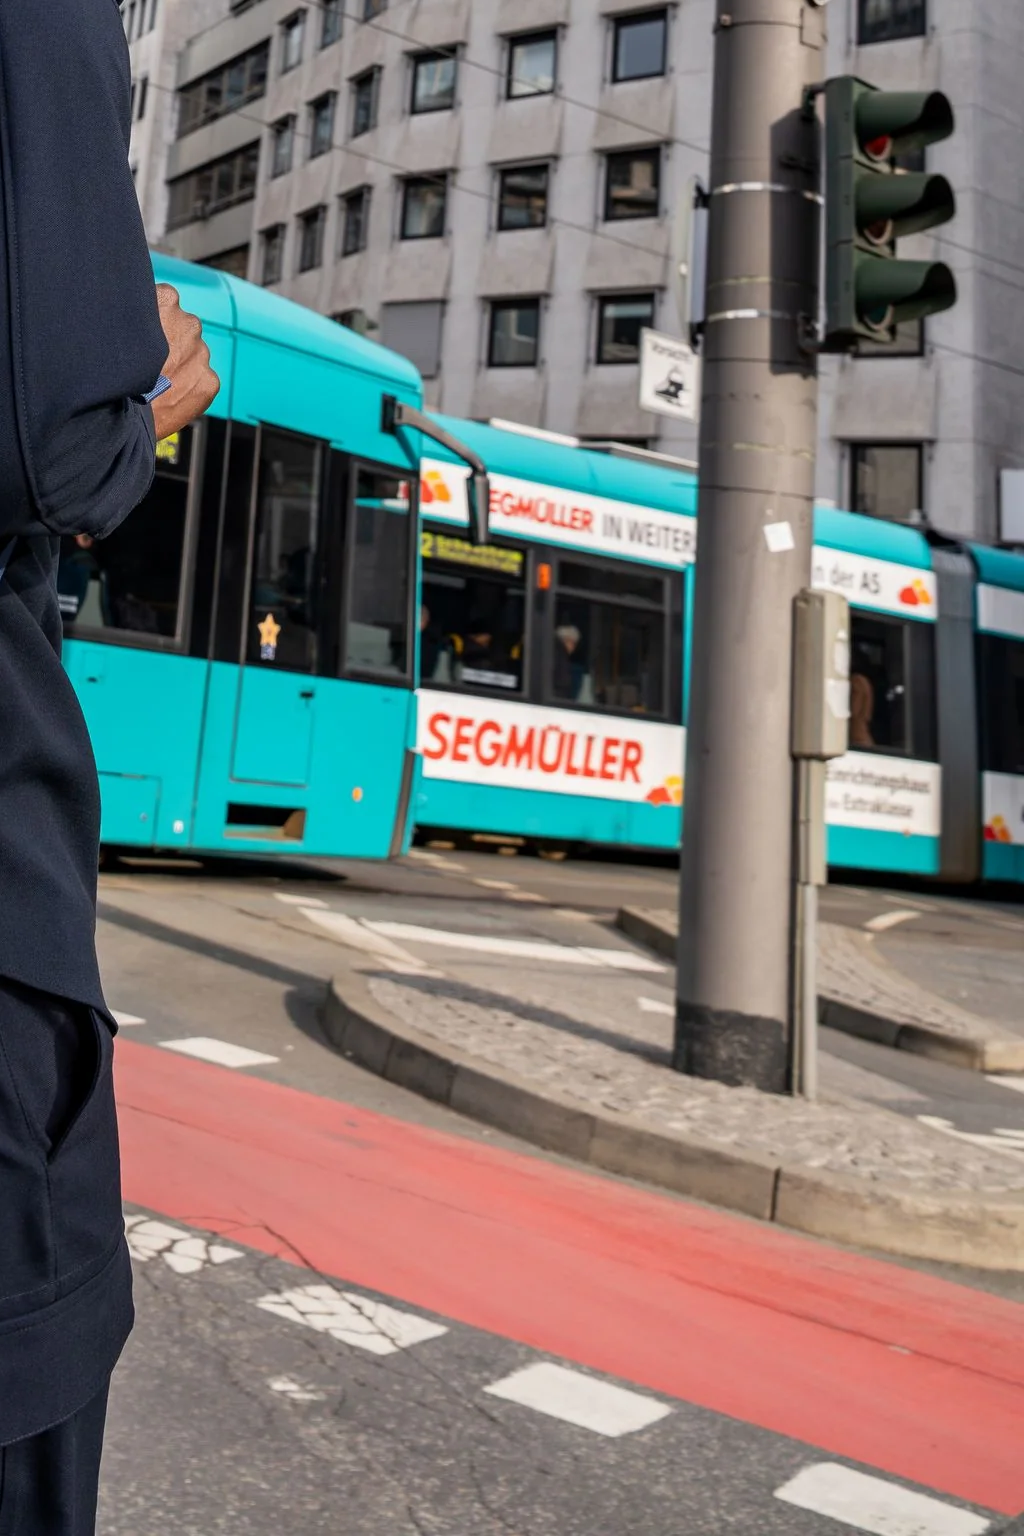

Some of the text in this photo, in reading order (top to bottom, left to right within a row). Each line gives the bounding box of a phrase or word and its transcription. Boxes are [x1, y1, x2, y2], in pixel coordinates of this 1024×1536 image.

[488, 488, 595, 534] EGMÜLLER
[602, 512, 623, 541] IN
[422, 711, 644, 784] SEGMÜLLER
